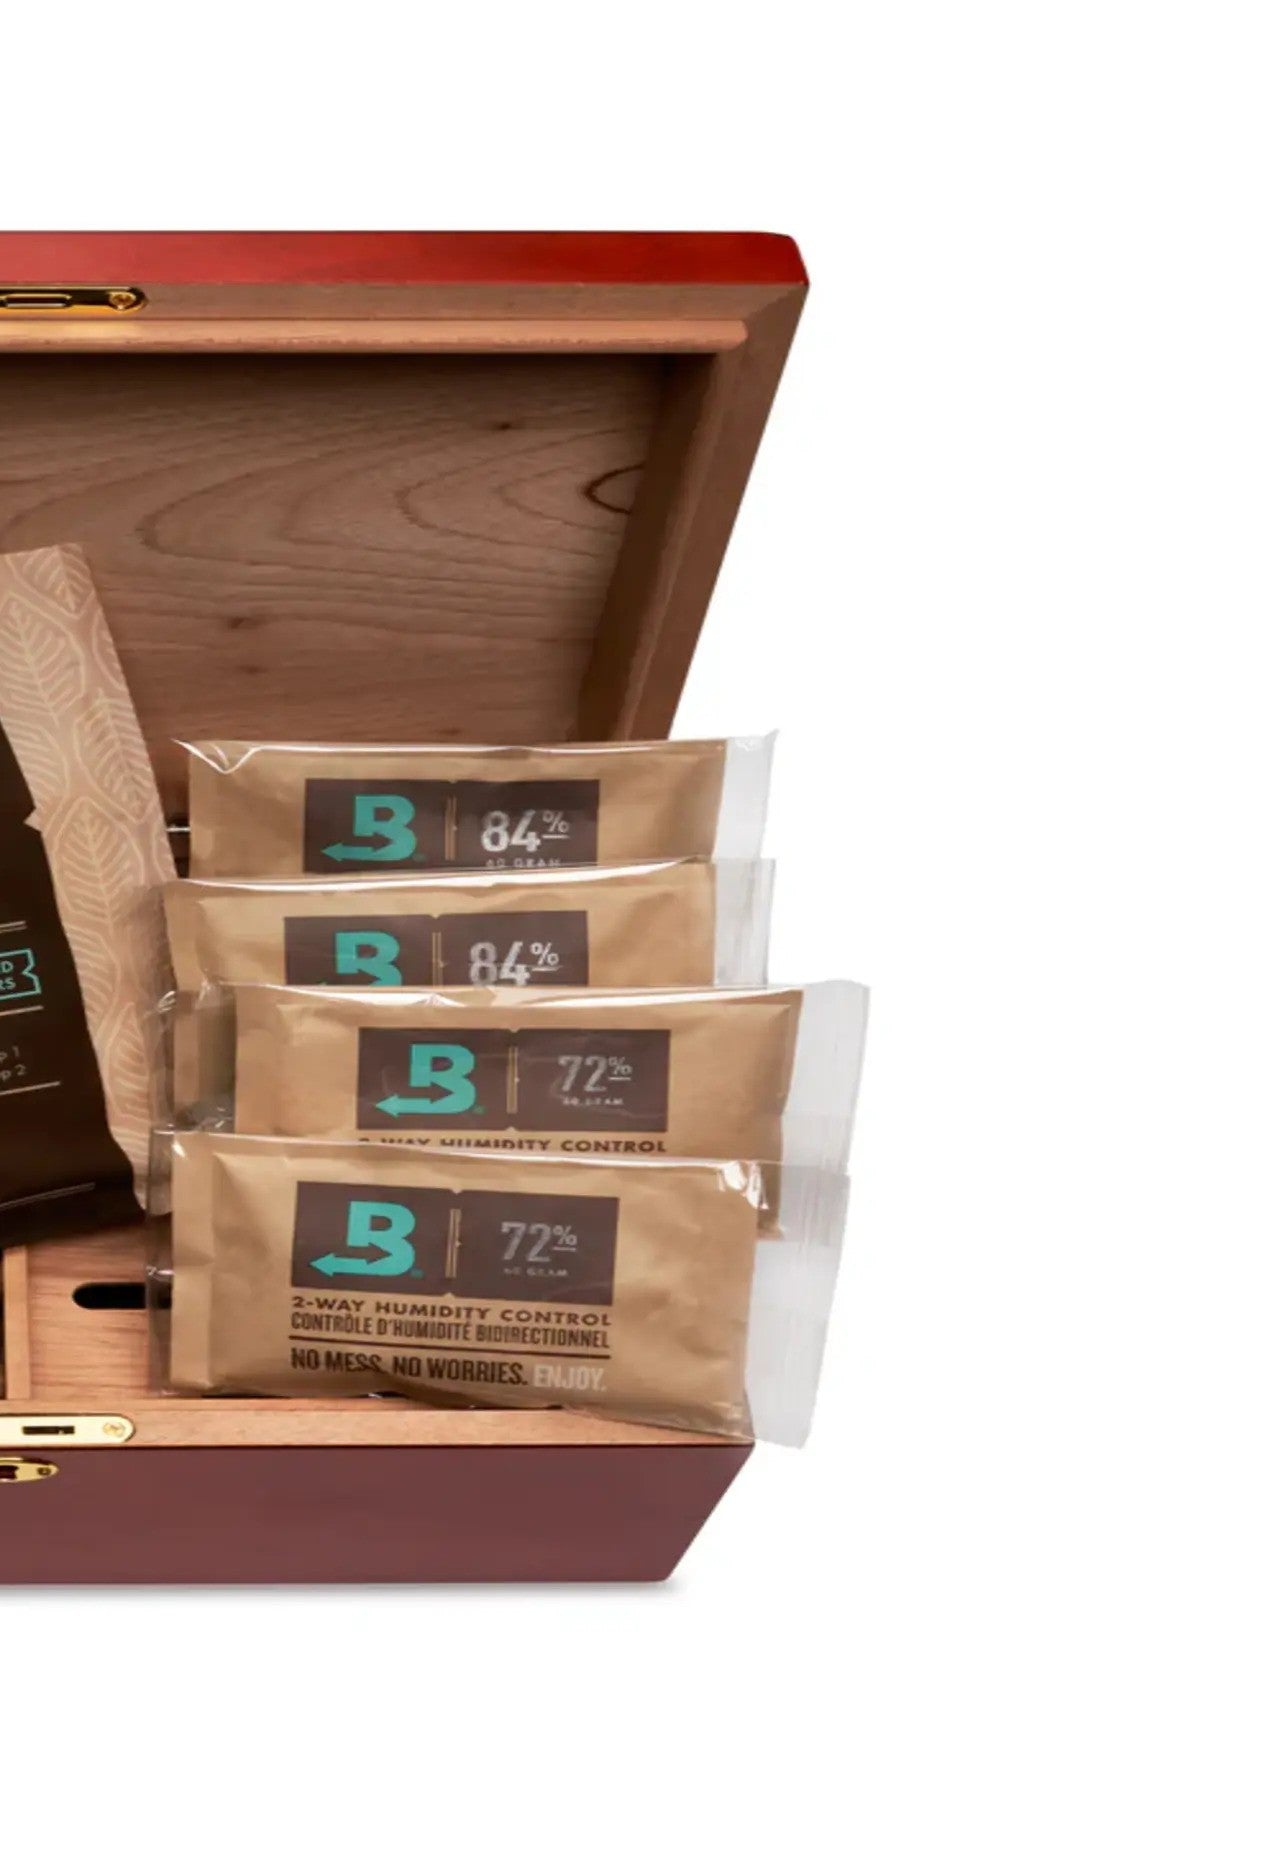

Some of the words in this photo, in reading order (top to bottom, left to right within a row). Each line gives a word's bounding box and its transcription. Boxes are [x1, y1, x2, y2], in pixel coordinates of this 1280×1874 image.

[480, 809, 570, 852] 84%
[469, 941, 560, 986] 84%
[12, 1046, 20, 1057] 1
[16, 1064, 27, 1076] 2
[557, 1055, 632, 1093] 72%
[560, 1140, 667, 1152] CONTROL
[501, 1221, 577, 1262] 72%
[291, 1311, 372, 1335] CONTRÔLE
[377, 1318, 471, 1342] D'HUMIDITÉ
[475, 1325, 611, 1349] BIDIRECTIONNEL
[292, 1296, 366, 1314] 2-WAY
[375, 1301, 491, 1321] HUMIDITY
[500, 1309, 612, 1328] CONTROL
[291, 1348, 319, 1371] NO
[392, 1355, 421, 1378] NO
[426, 1358, 529, 1386] WORRIES.
[533, 1363, 607, 1392] ENJOY.
